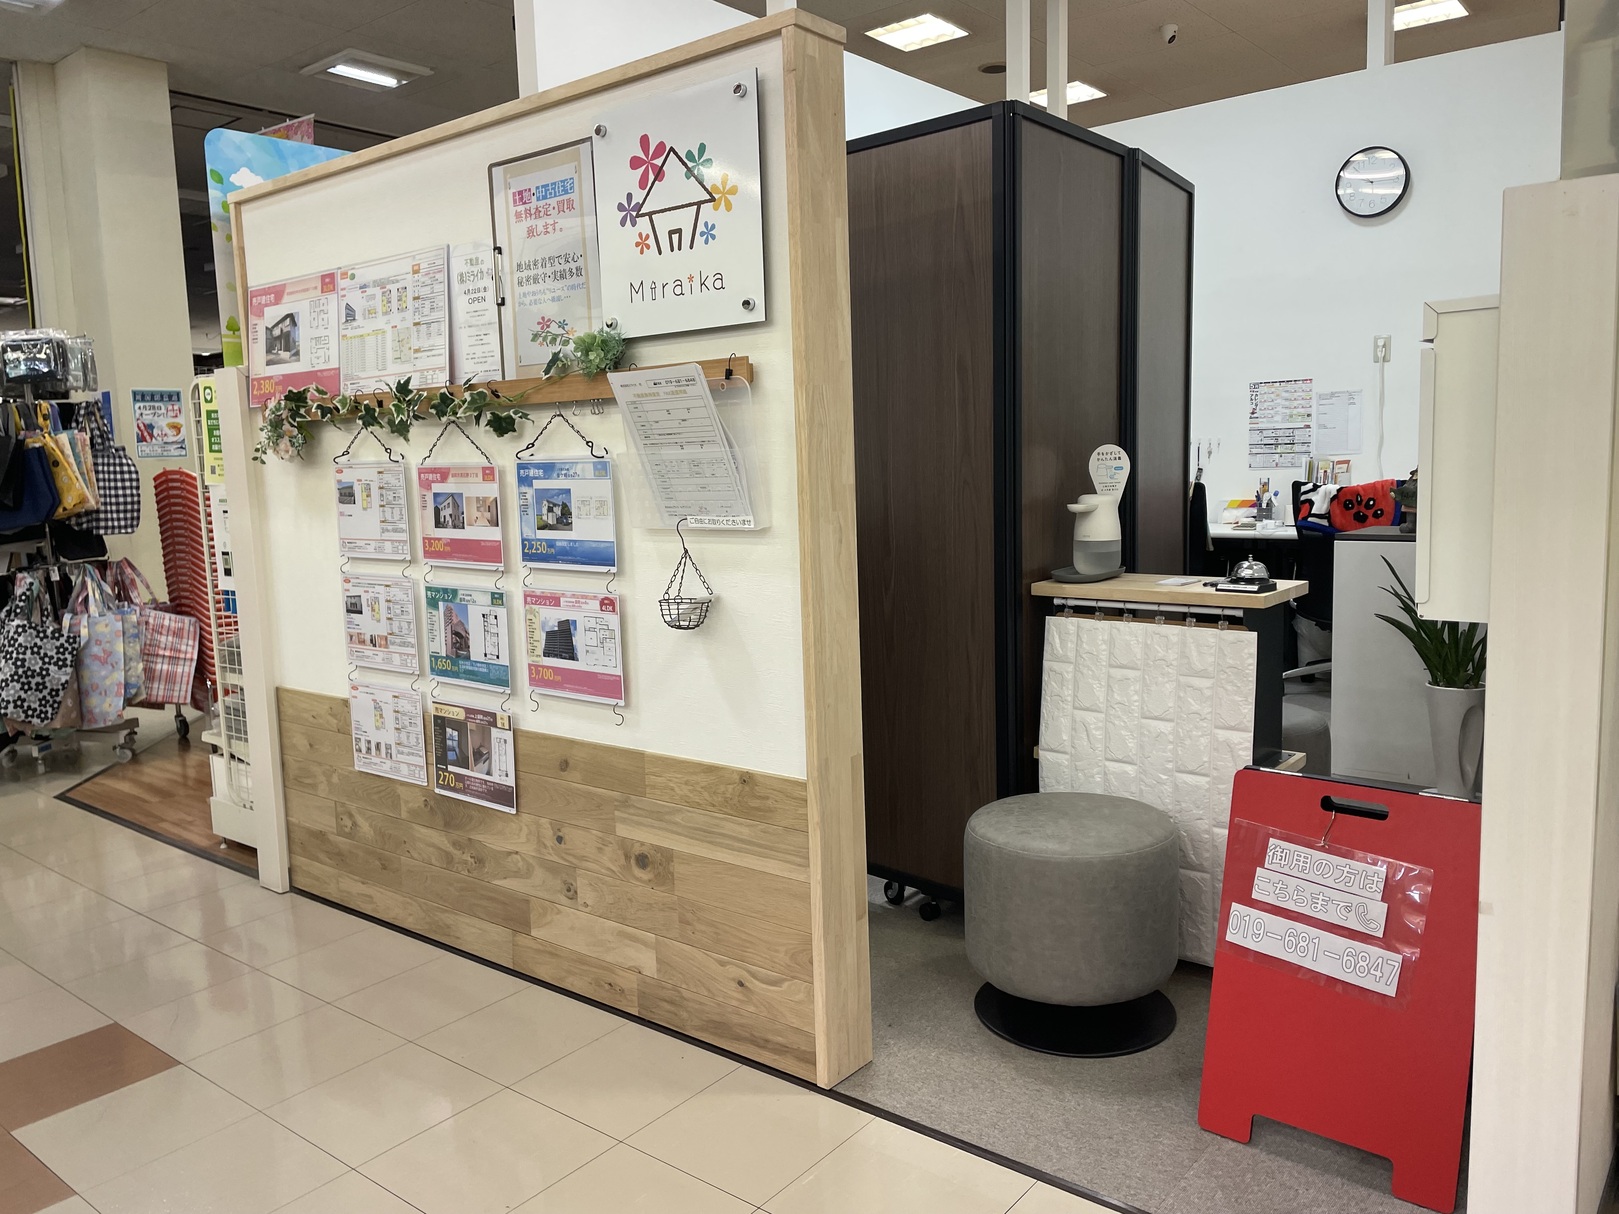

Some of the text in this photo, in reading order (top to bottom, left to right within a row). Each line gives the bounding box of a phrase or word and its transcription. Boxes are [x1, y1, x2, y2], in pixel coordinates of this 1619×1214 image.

[514, 199, 576, 224] 無料査定・買取
[526, 220, 563, 239] 致します。
[517, 266, 584, 288] 秘密厳守・実績多数
[630, 270, 725, 303] Miraika
[468, 296, 486, 304] OPEN
[253, 381, 275, 395] 2,380
[424, 539, 444, 552] 3,200
[523, 541, 547, 555] 2,250
[431, 658, 451, 671] 1,650
[530, 666, 554, 681] 3,700
[438, 771, 455, 787] 270
[1267, 844, 1383, 895] 御用の方は
[1253, 874, 1353, 921] こちらまで
[1228, 910, 1401, 986] 019-681-6847
